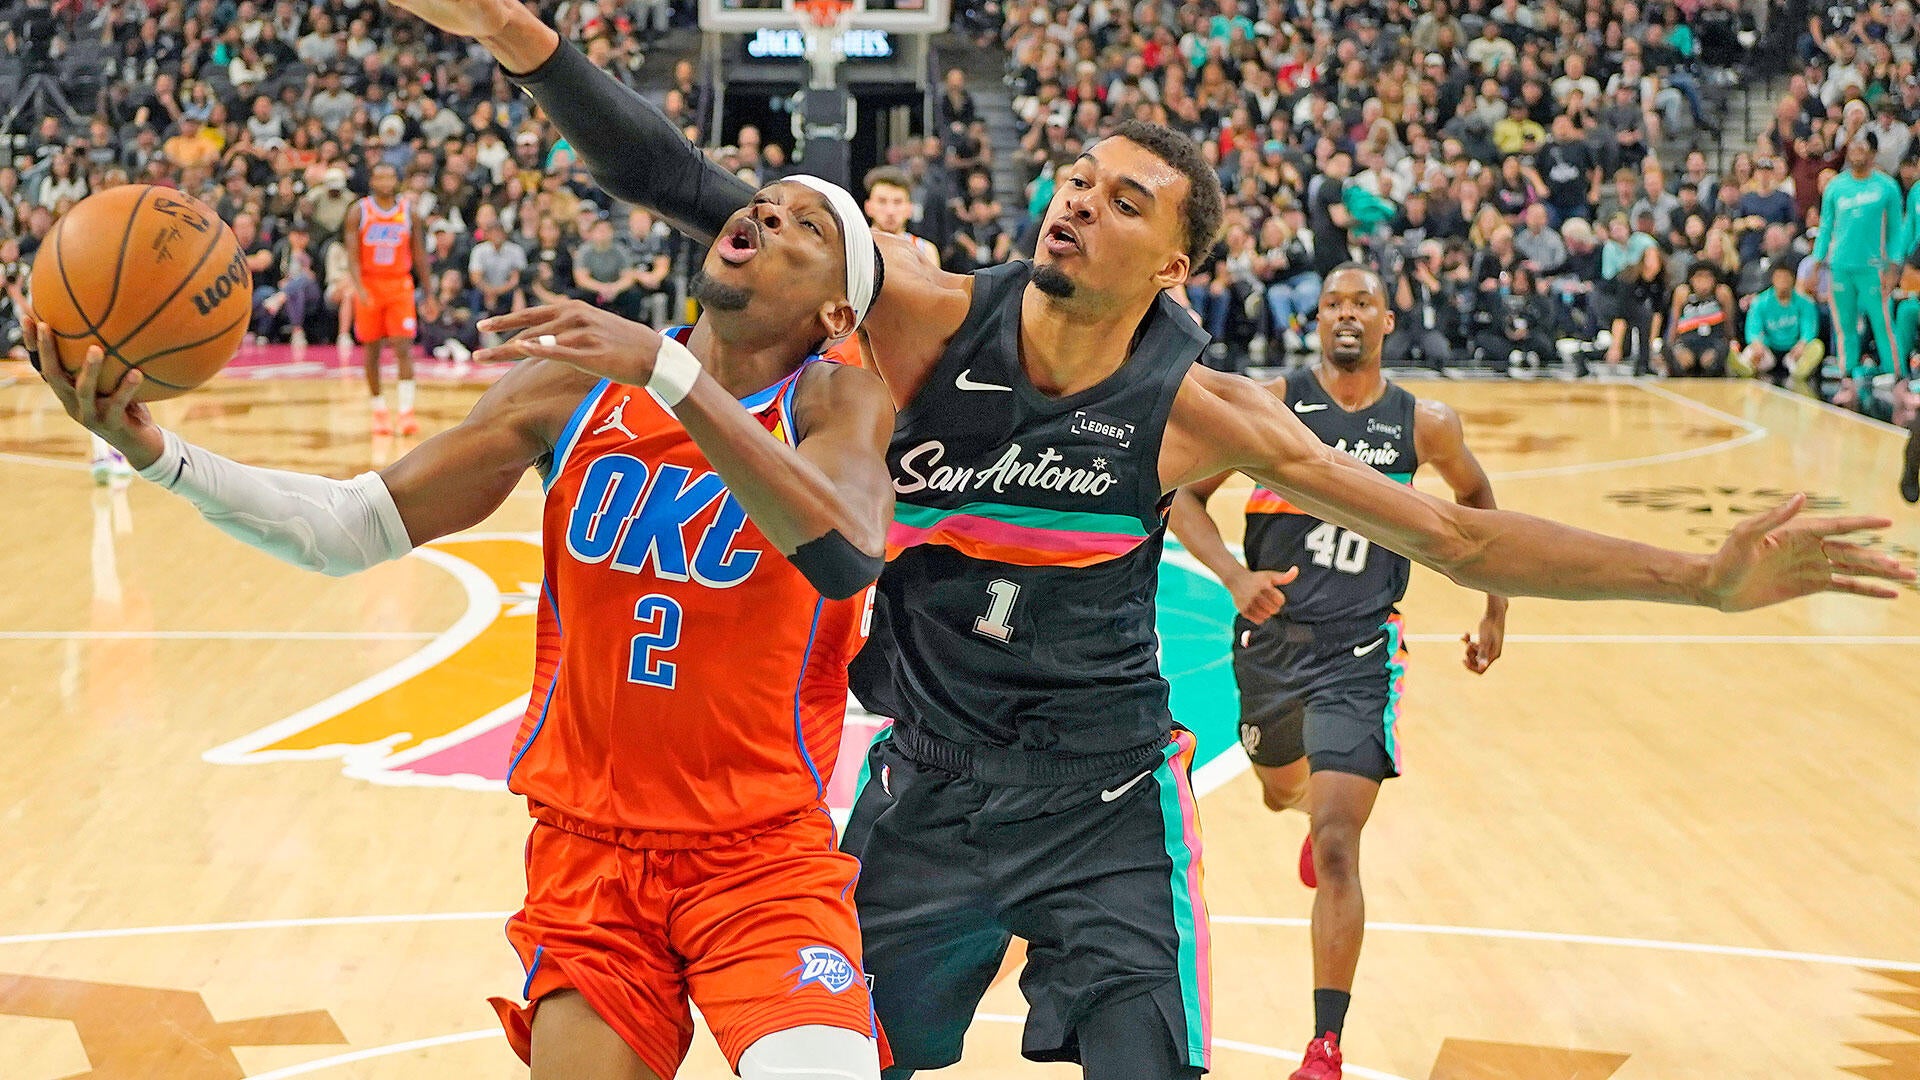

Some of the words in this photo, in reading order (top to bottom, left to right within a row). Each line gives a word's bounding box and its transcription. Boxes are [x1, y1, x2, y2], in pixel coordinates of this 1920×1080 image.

[1079, 418, 1126, 441] LEDGER
[892, 439, 974, 496] San
[975, 442, 1118, 497] Antonio
[565, 453, 763, 589] OKC
[1303, 521, 1370, 576] 40
[972, 578, 1022, 644] 1
[627, 593, 684, 690] 2
[801, 957, 847, 981] OKC
